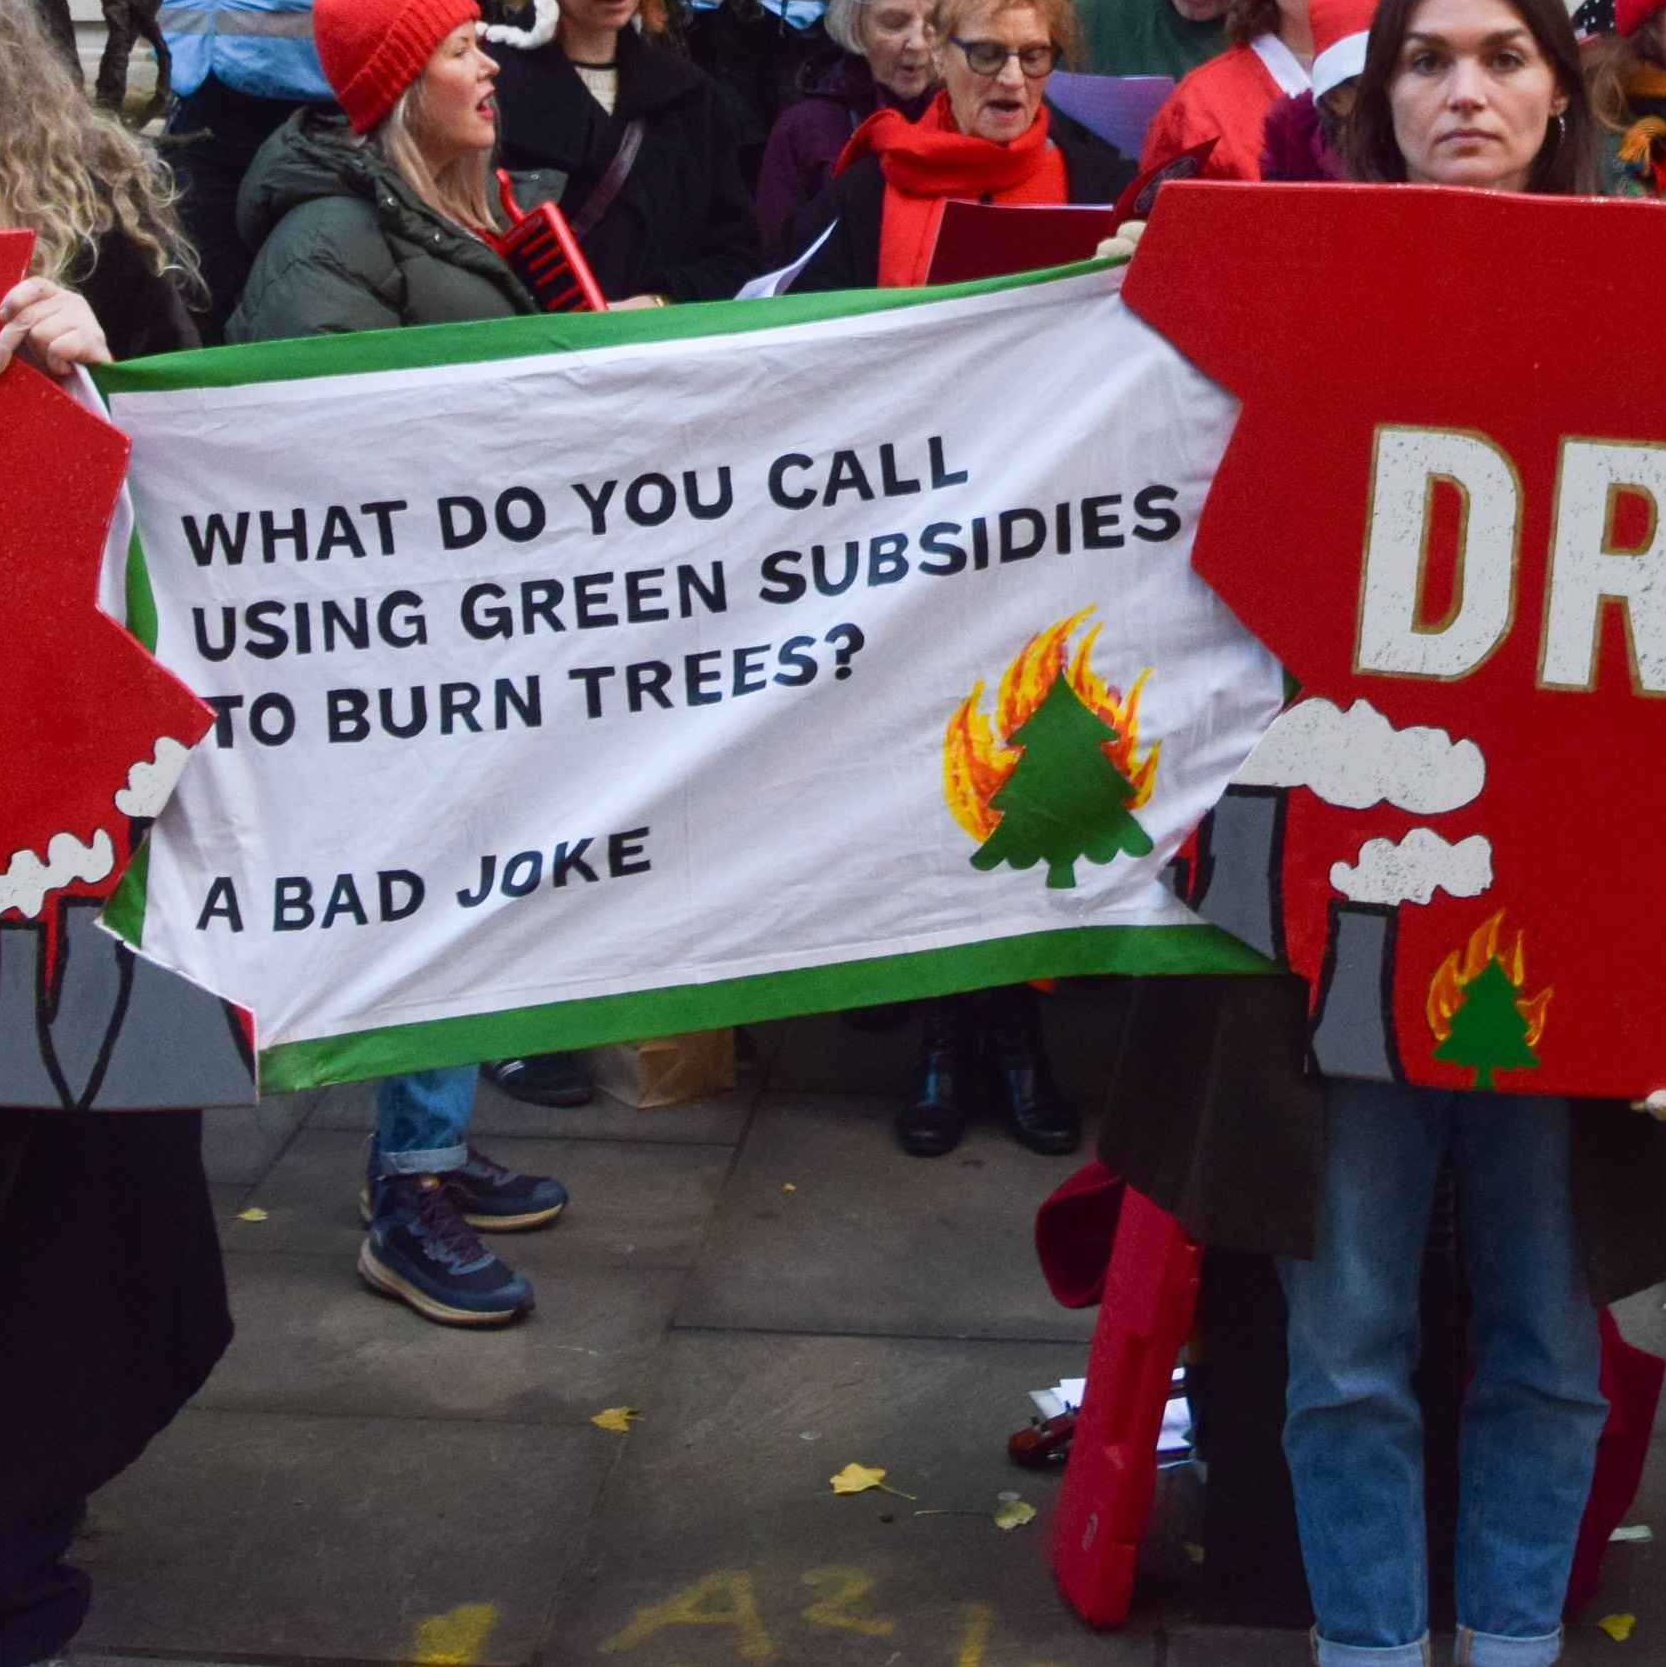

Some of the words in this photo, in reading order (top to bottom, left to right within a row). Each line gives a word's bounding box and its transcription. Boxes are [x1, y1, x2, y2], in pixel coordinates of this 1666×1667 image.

[181, 498, 408, 567] WHAT
[437, 485, 547, 551] DO
[571, 465, 733, 536] YOU
[767, 435, 968, 511] CALL
[191, 589, 428, 662] USING
[460, 560, 727, 641] GREEN
[758, 484, 1182, 605] SUBSIDIES
[200, 691, 296, 750] TO
[326, 674, 543, 744] BURN
[568, 622, 865, 719] TREES?
[194, 875, 244, 934] A
[272, 868, 426, 933] BAD
[455, 826, 651, 909] JOKE
